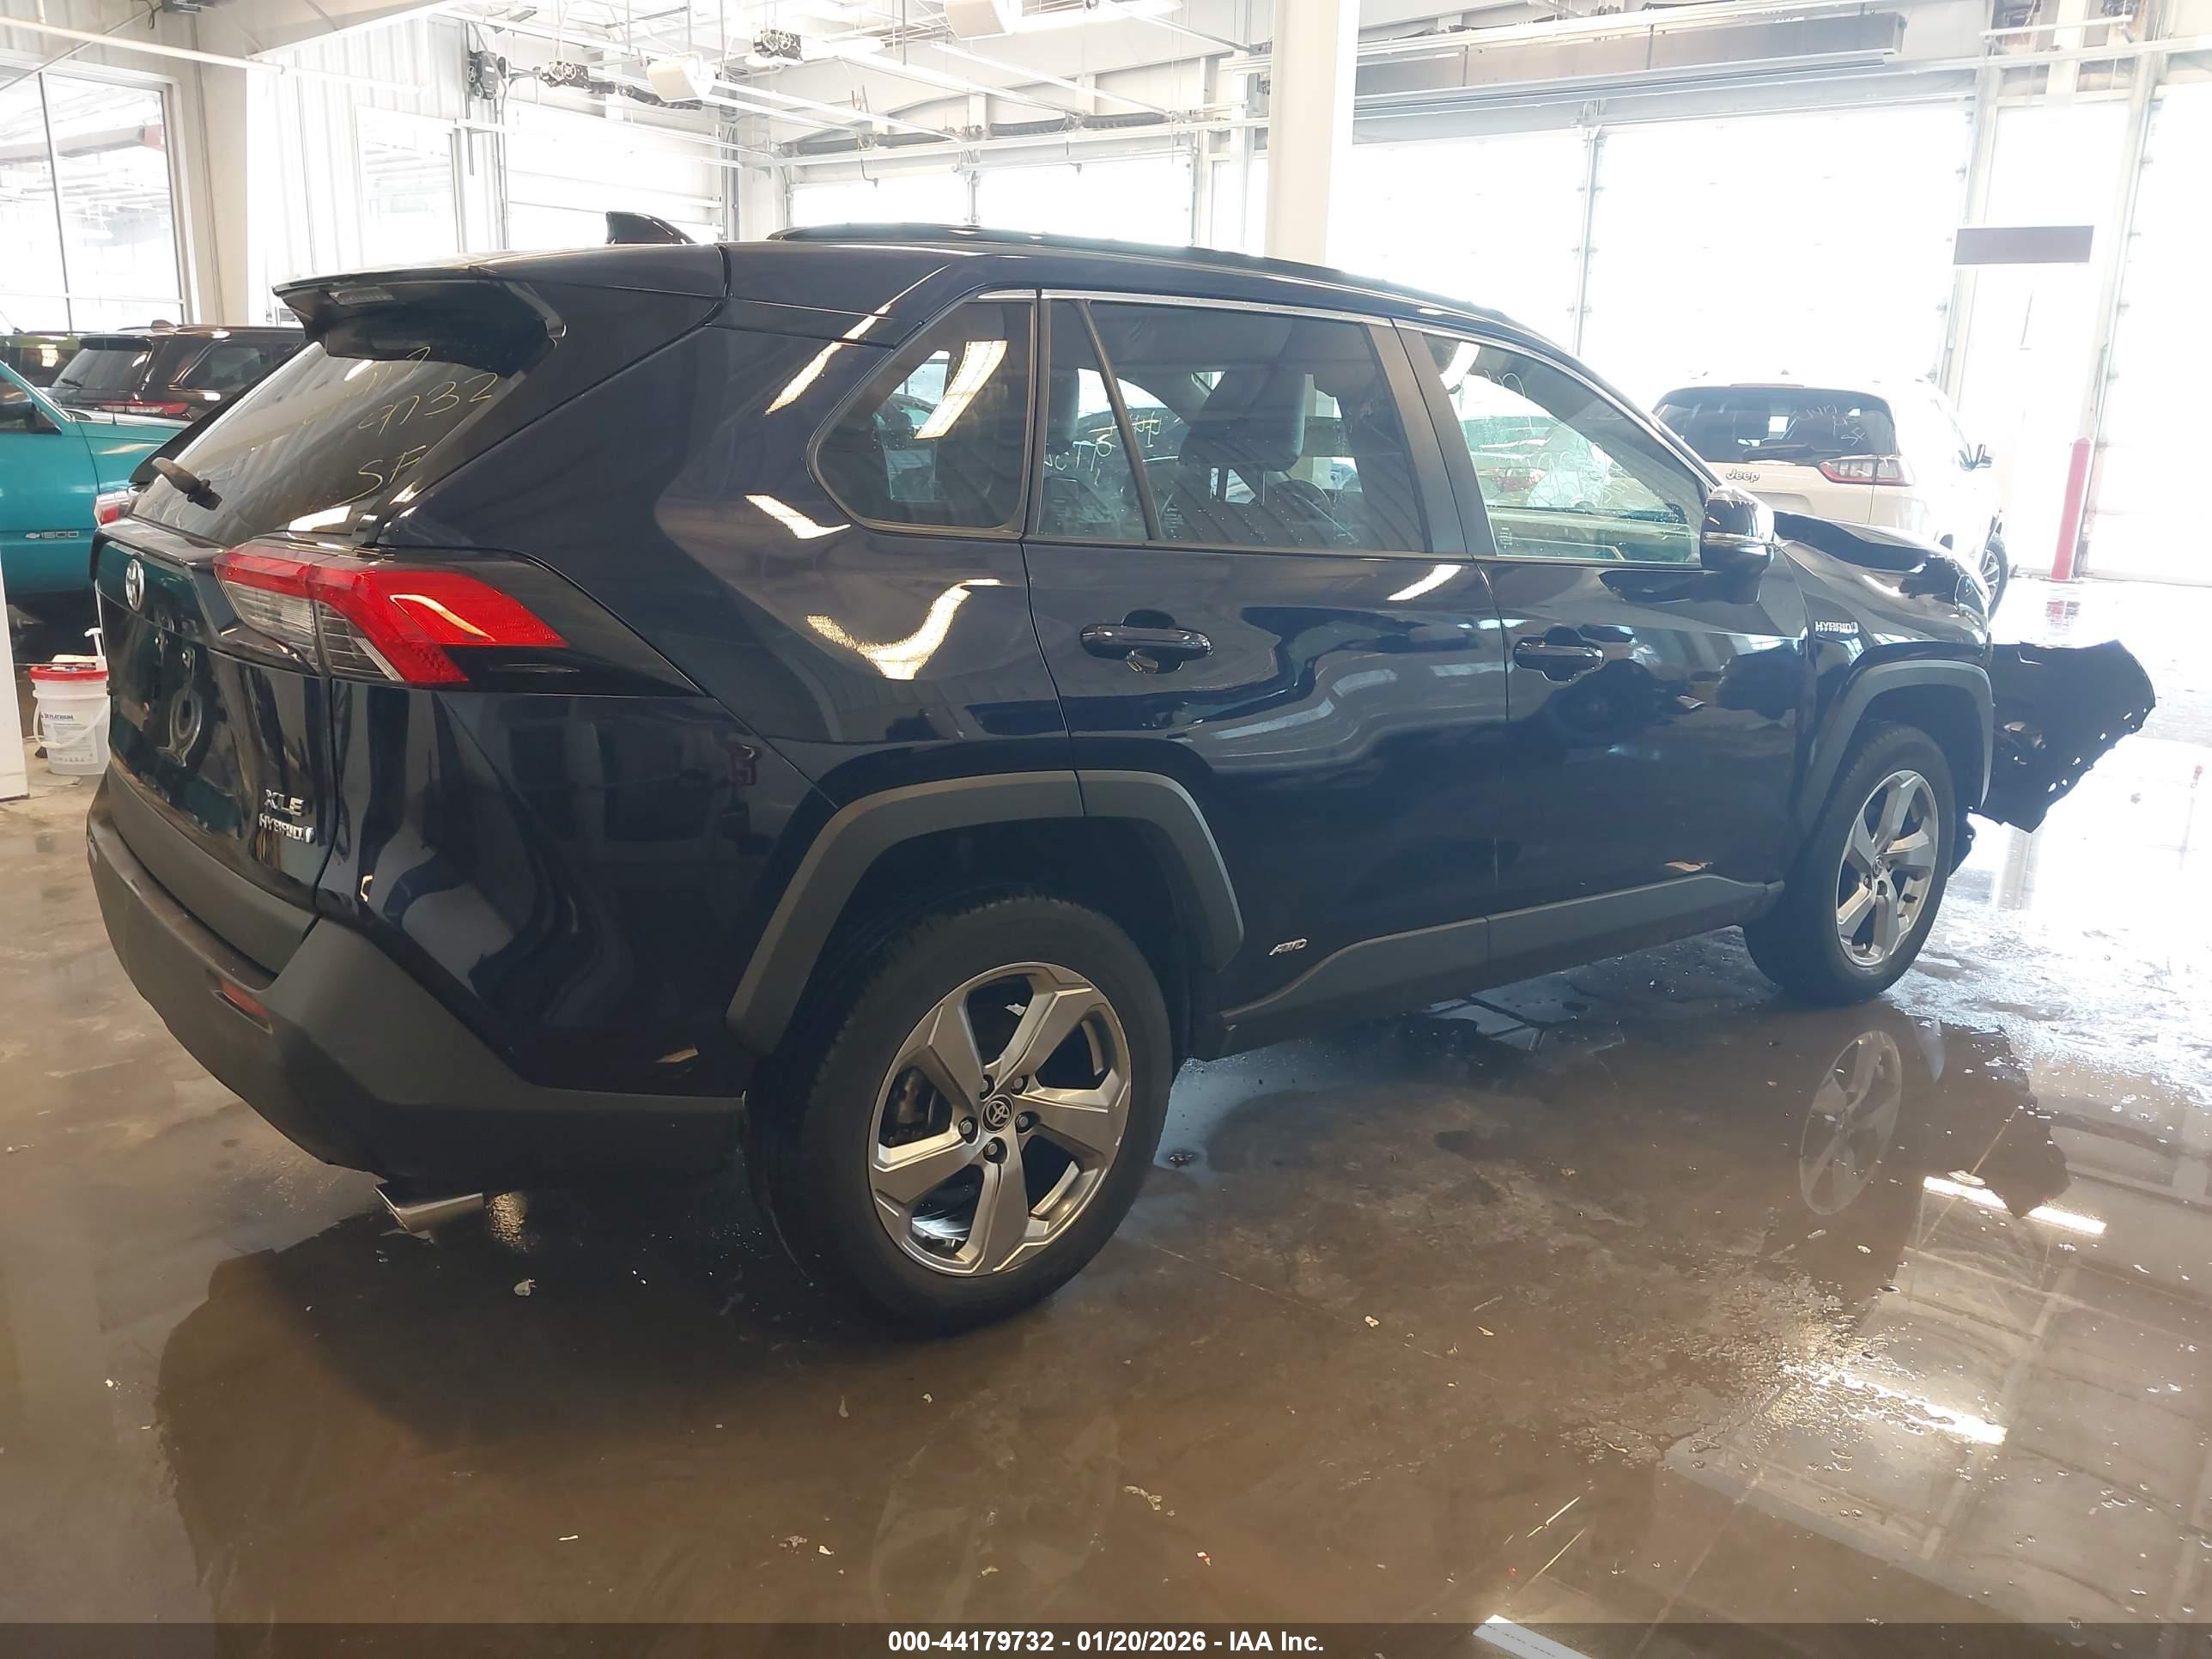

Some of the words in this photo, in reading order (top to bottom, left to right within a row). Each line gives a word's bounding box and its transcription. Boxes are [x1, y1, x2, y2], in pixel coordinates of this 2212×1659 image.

[1725, 468, 1760, 483] Jeep
[1814, 621, 1852, 634] HYBRID
[264, 788, 305, 817] XLE
[258, 812, 304, 842] HYBRID
